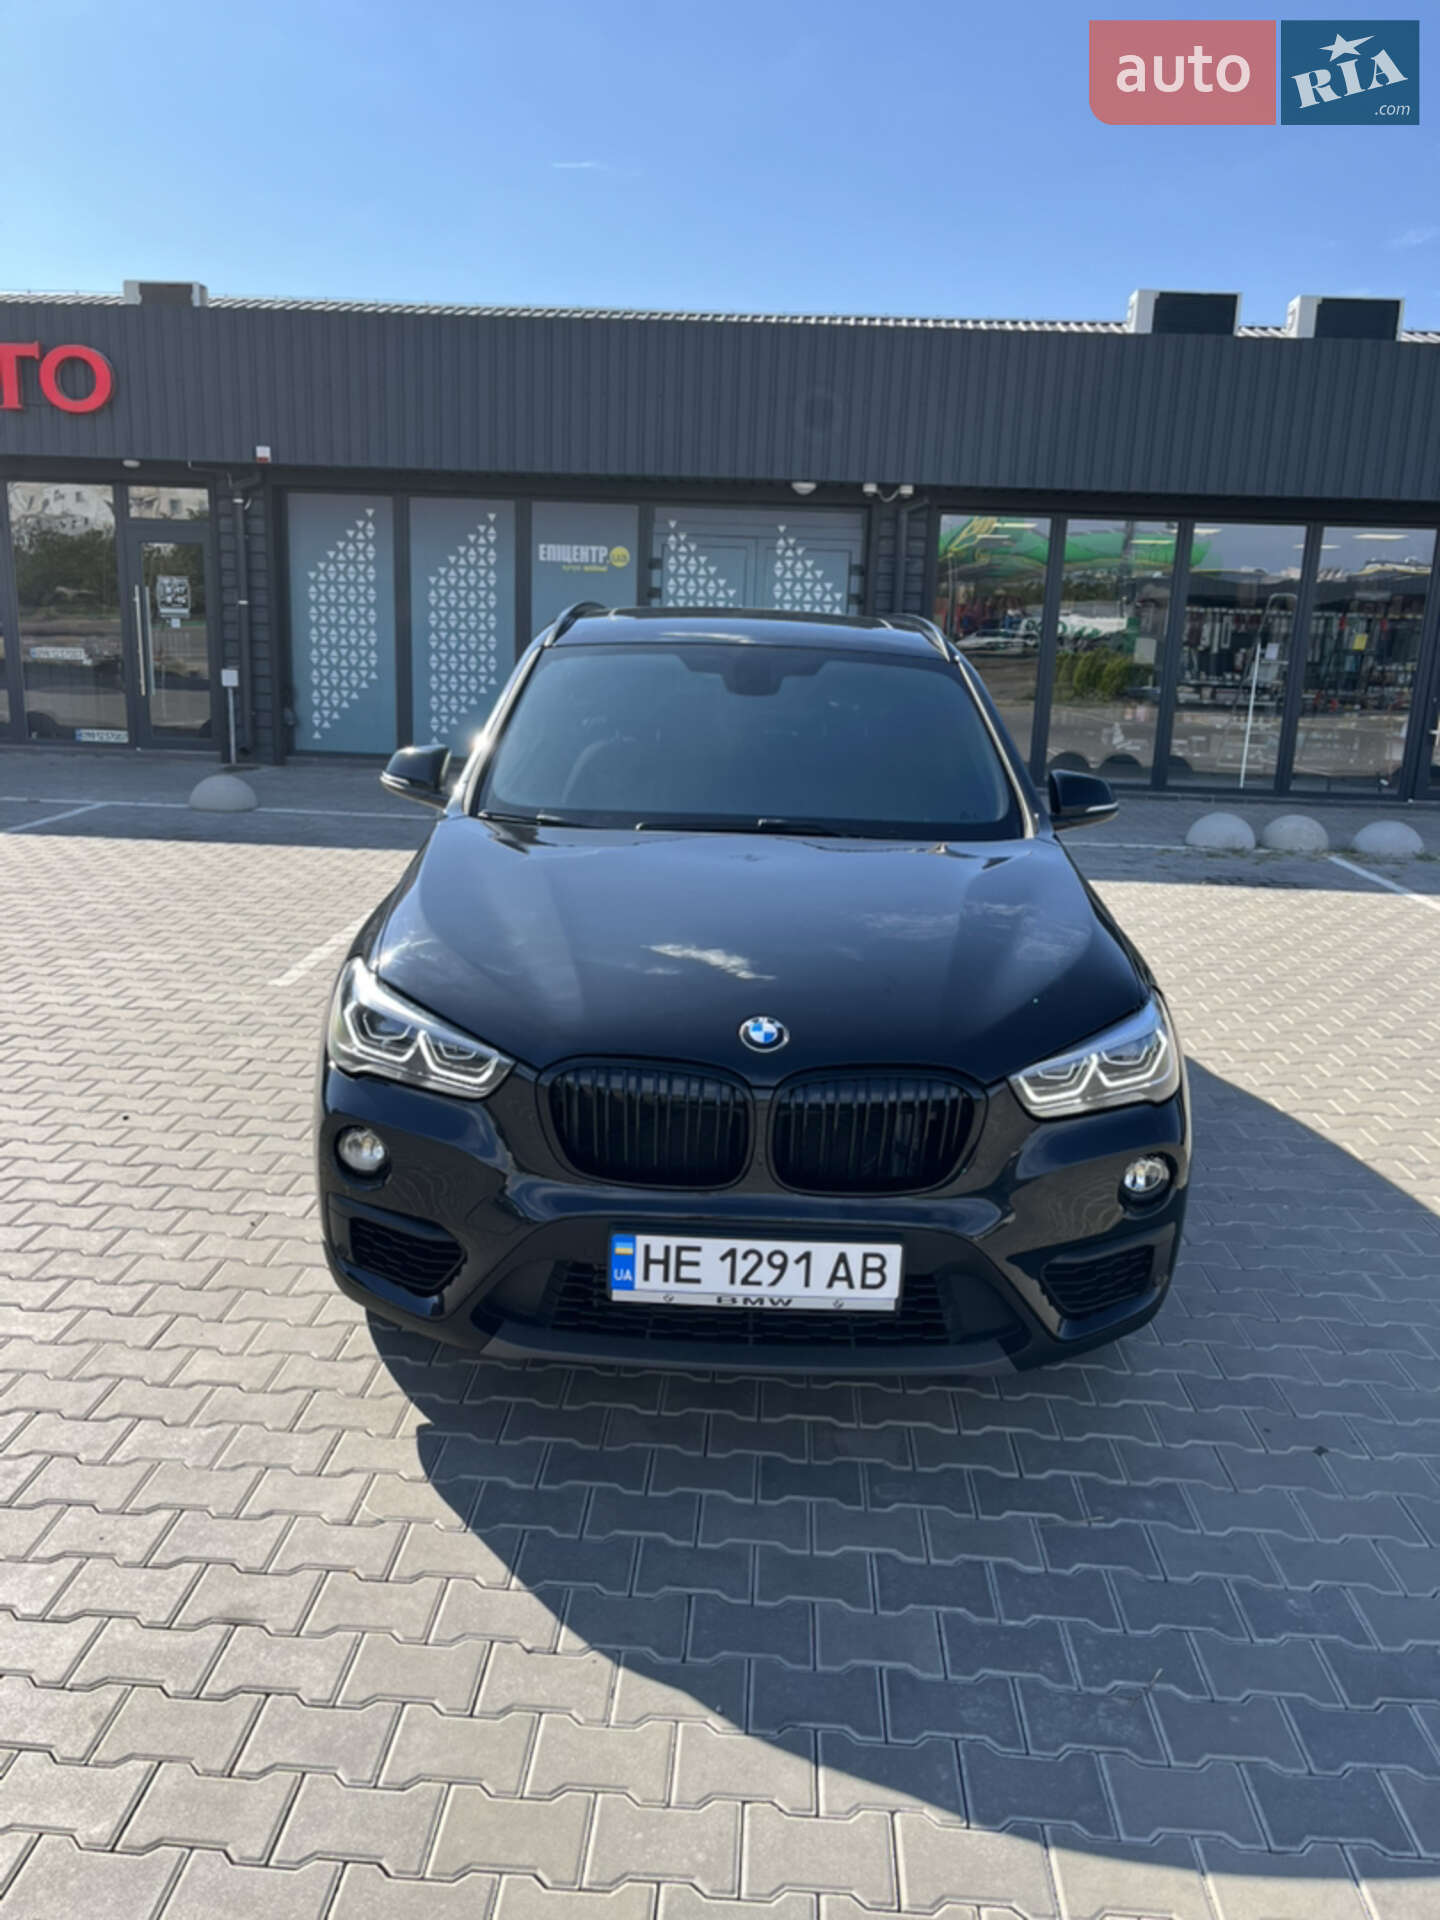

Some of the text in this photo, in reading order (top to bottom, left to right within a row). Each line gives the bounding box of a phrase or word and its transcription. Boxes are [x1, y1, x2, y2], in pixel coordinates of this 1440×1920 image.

[643, 1243, 888, 1290] HE 1291 AB
[614, 1270, 633, 1282] UA
[716, 1295, 793, 1307] BMW
